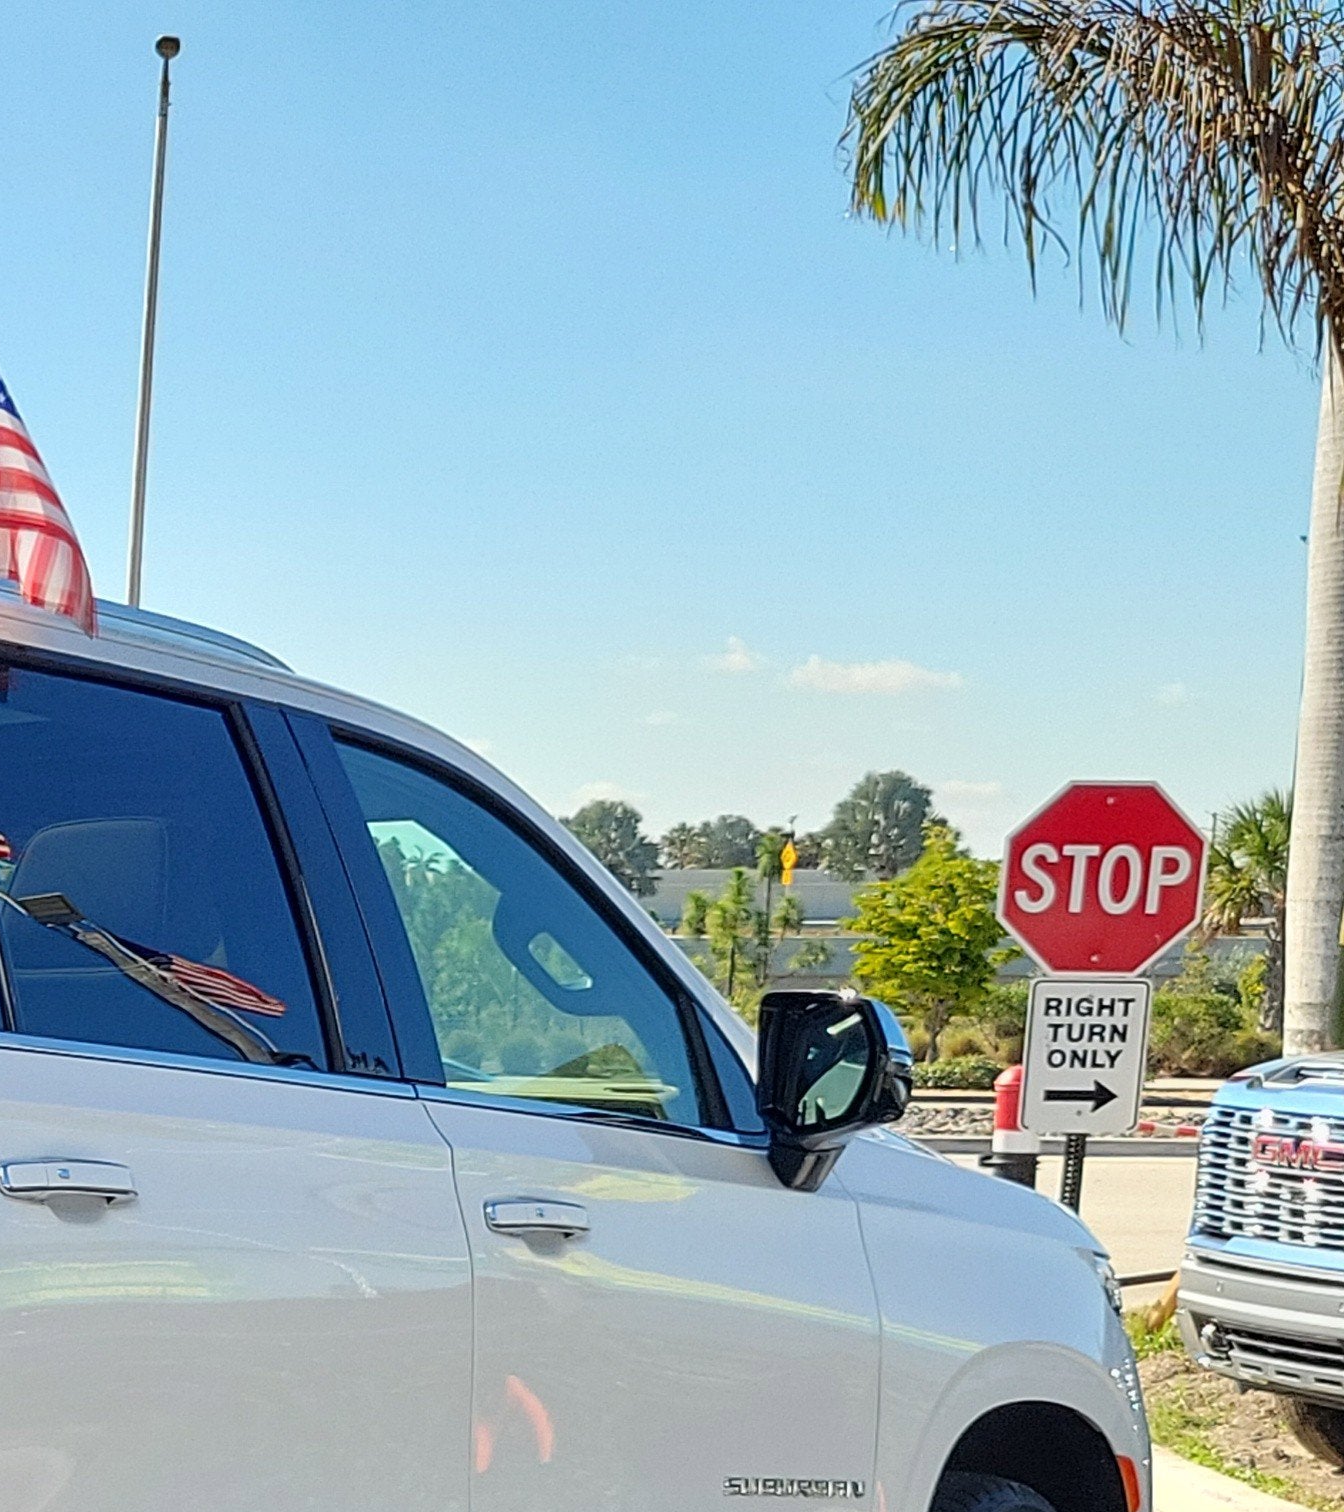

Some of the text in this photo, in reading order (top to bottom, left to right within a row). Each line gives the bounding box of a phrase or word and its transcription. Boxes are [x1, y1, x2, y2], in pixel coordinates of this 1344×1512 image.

[1014, 842, 1193, 915] STOP
[1043, 996, 1137, 1018] RIGHT
[1046, 1022, 1129, 1043] TURN
[1046, 1048, 1124, 1069] ONLY
[1252, 1134, 1344, 1172] GMC
[723, 1476, 865, 1499] SUBURBAN
